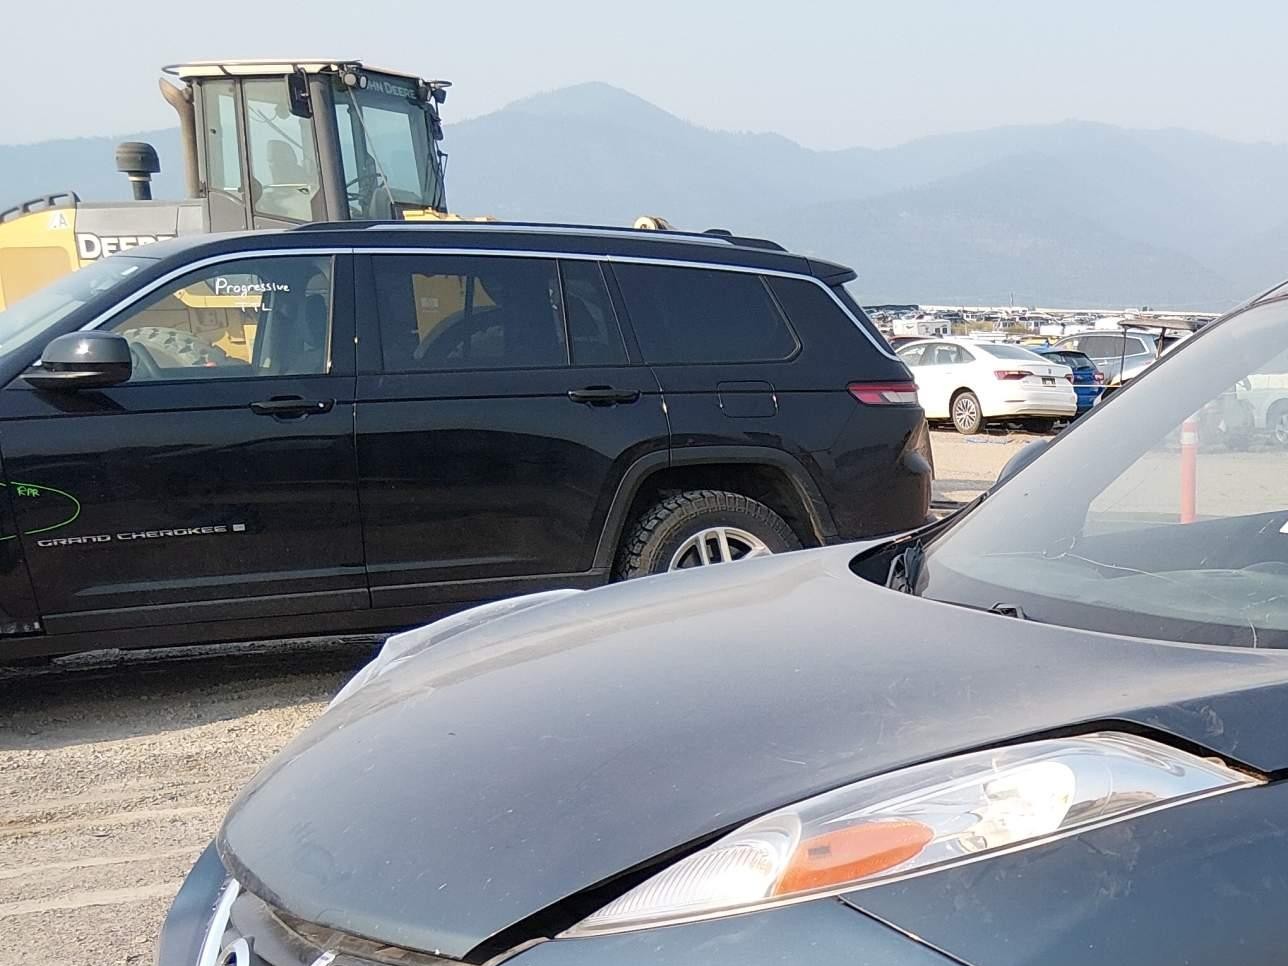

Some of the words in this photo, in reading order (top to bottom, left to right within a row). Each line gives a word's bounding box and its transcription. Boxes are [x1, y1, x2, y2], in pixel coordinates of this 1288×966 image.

[215, 277, 290, 297] Progressive
[37, 534, 111, 547] GRAND
[116, 525, 228, 540] CHEROKEE
